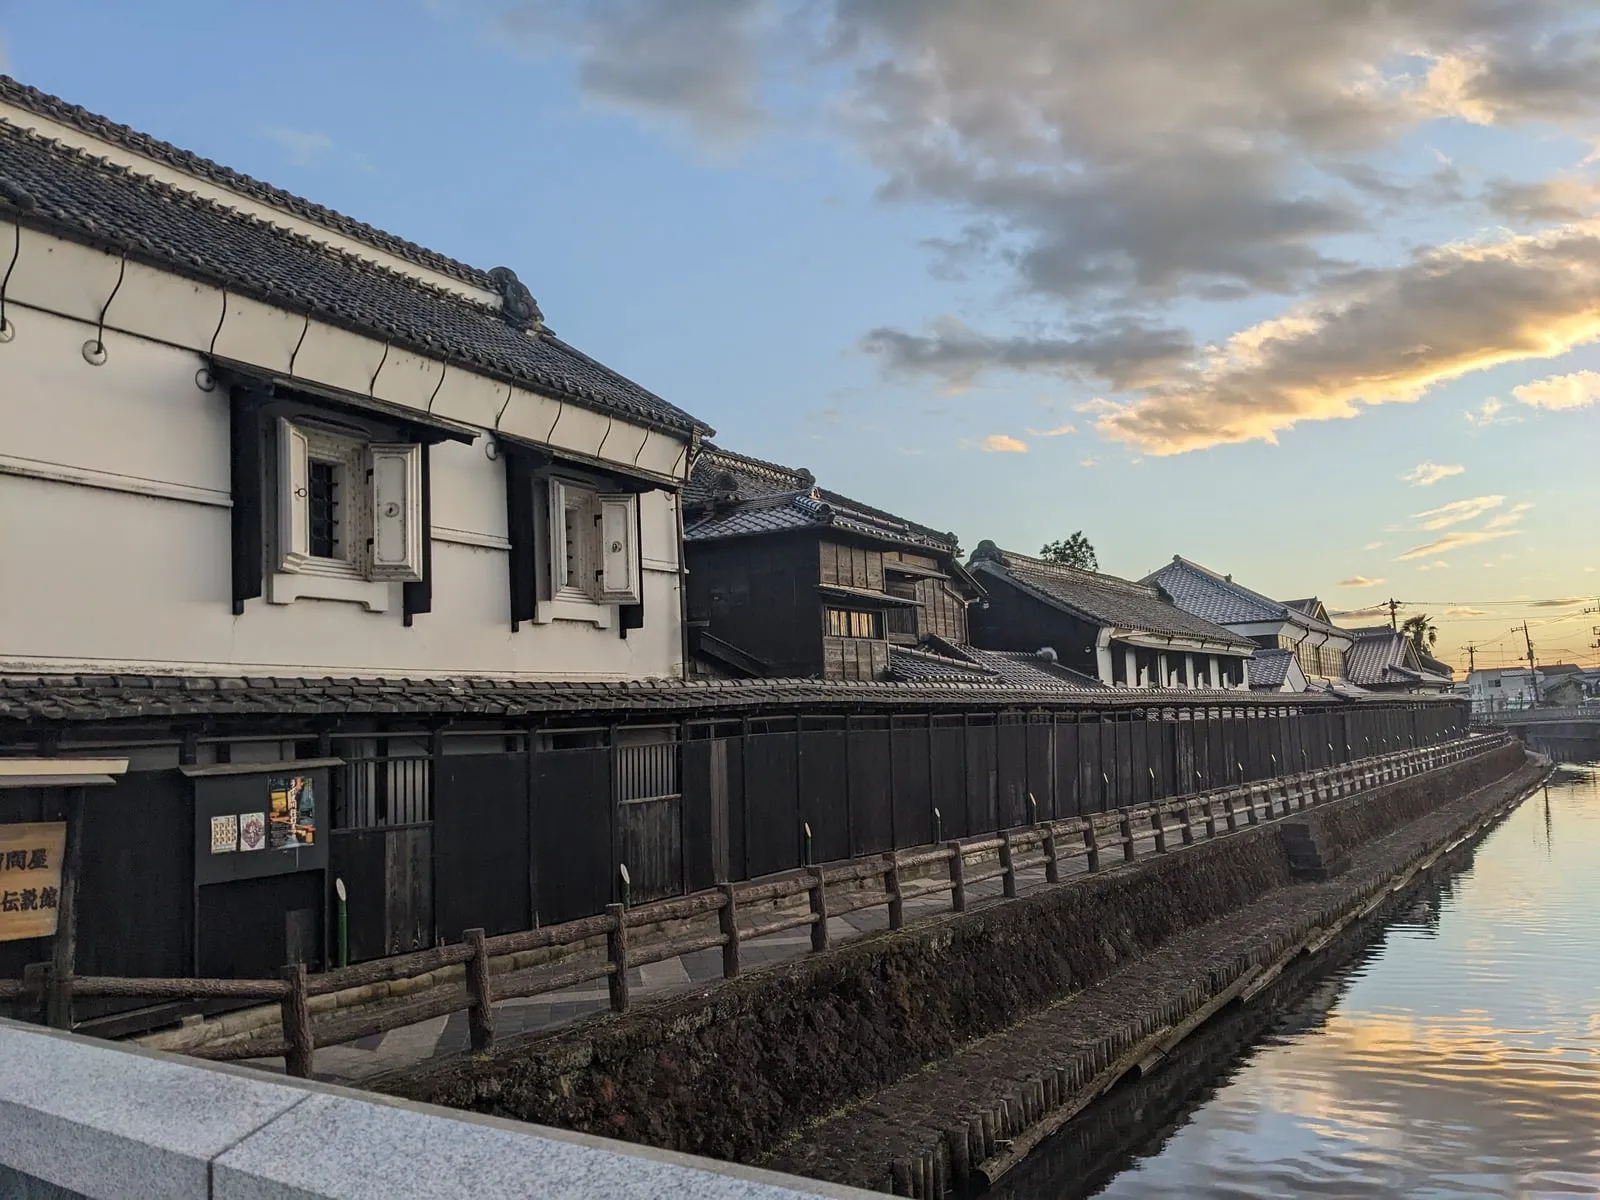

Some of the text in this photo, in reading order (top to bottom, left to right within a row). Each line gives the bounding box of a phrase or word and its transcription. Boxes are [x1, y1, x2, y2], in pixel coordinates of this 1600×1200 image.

[0, 848, 48, 871] 問屋
[0, 886, 58, 912] 伝説館
